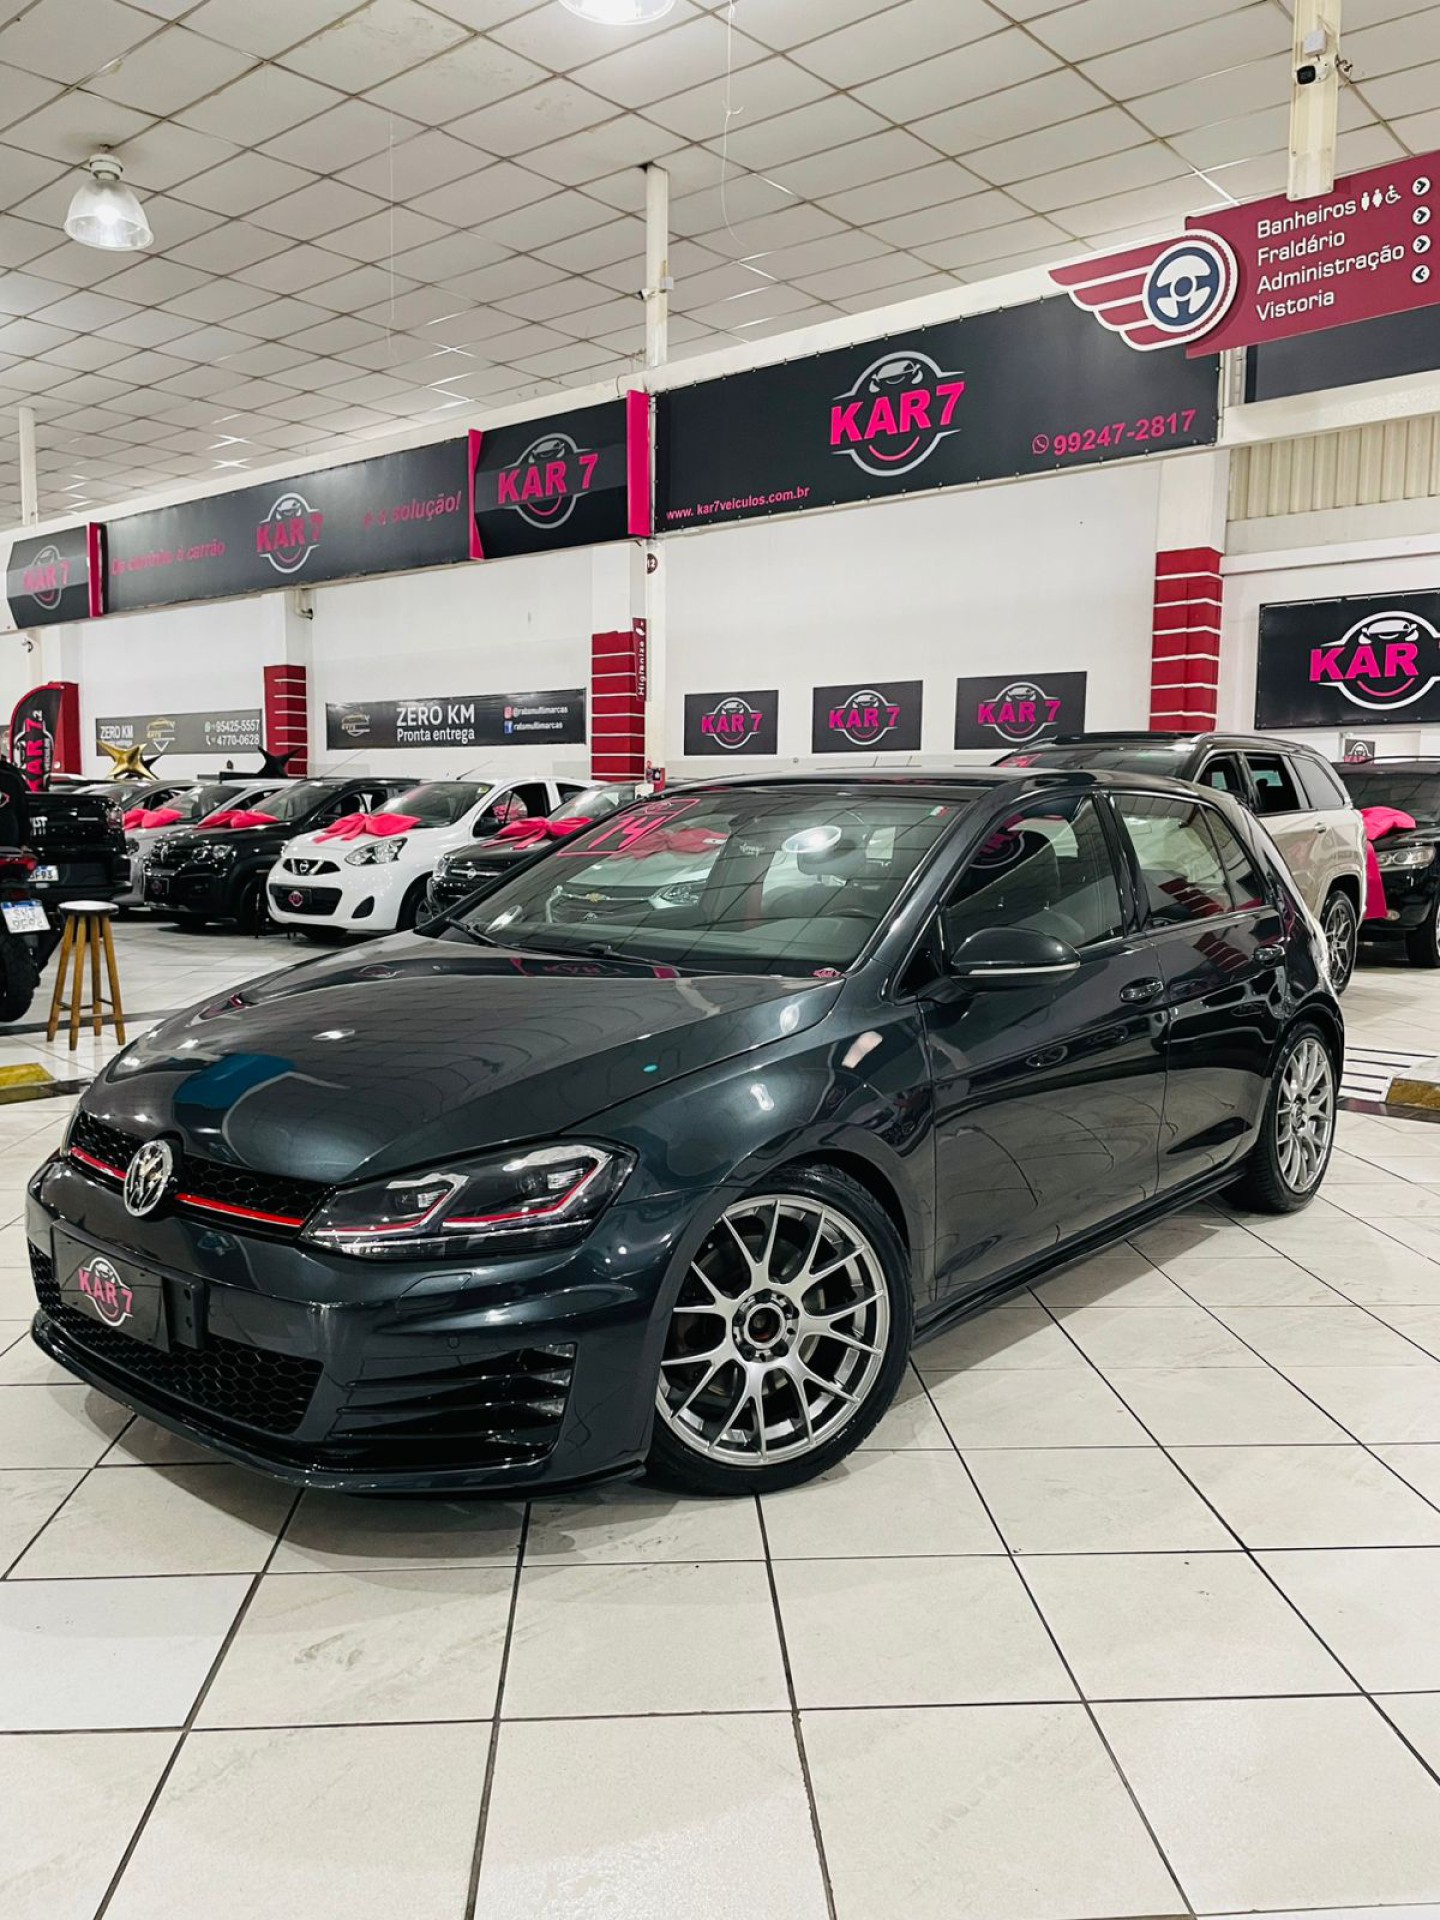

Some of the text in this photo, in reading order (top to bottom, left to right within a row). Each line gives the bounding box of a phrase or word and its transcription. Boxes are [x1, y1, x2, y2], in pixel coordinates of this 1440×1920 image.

[1257, 198, 1356, 239] Banheiros
[1257, 229, 1345, 266] Fraldário
[1256, 242, 1405, 295] Administração
[1256, 290, 1334, 321] Vistoria
[1053, 408, 1197, 456] 99247-2817
[497, 453, 599, 504] KAR 7
[391, 491, 462, 522] solução!
[1309, 643, 1419, 682] KAR
[100, 725, 120, 738] ZERO
[396, 703, 475, 727] ZERO KM
[977, 702, 1036, 724] KAR
[396, 727, 475, 744] Pronta entrega
[78, 1268, 133, 1313] KAR 7
